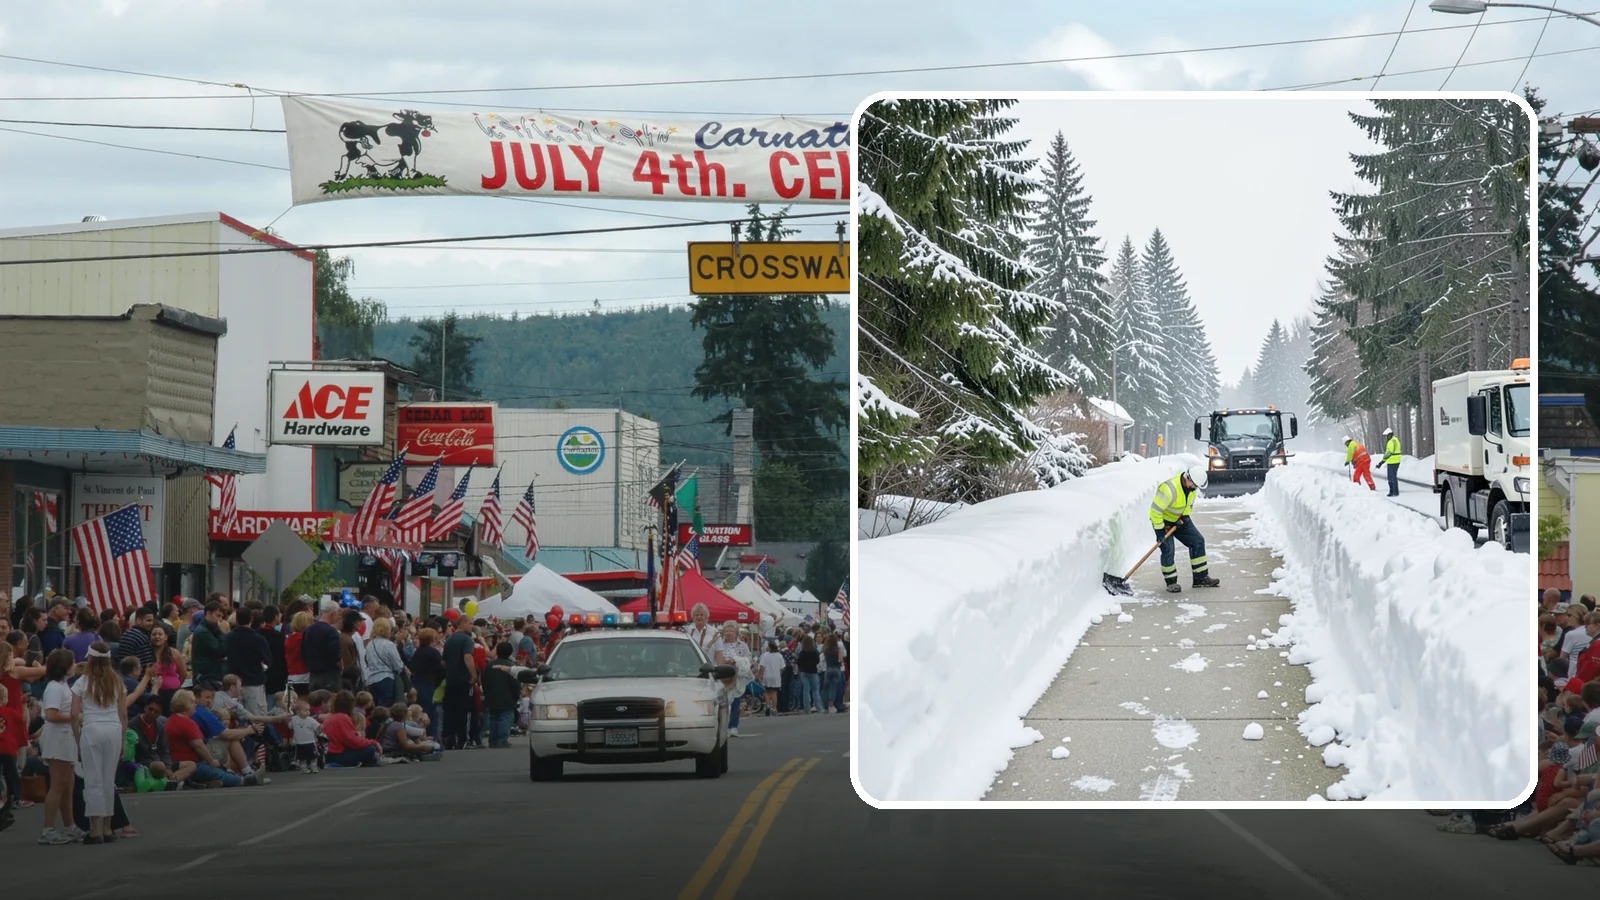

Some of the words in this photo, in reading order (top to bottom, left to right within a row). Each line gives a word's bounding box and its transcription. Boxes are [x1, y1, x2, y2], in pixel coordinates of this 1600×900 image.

[695, 122, 850, 149] Carnat
[481, 141, 604, 192] JULY
[632, 150, 746, 197] 4th.
[697, 254, 850, 280] CROSSWA
[283, 380, 373, 419] ACE
[406, 410, 452, 422] CEDAR
[461, 410, 485, 421] LOG
[283, 421, 370, 436] Hardware
[416, 428, 477, 447] Coca-Cola
[83, 485, 93, 494] St.
[96, 485, 124, 494] Vincent
[126, 486, 135, 494] de
[138, 486, 155, 495] Paul
[688, 526, 741, 535] CRNATION
[699, 535, 730, 543] GLASS
